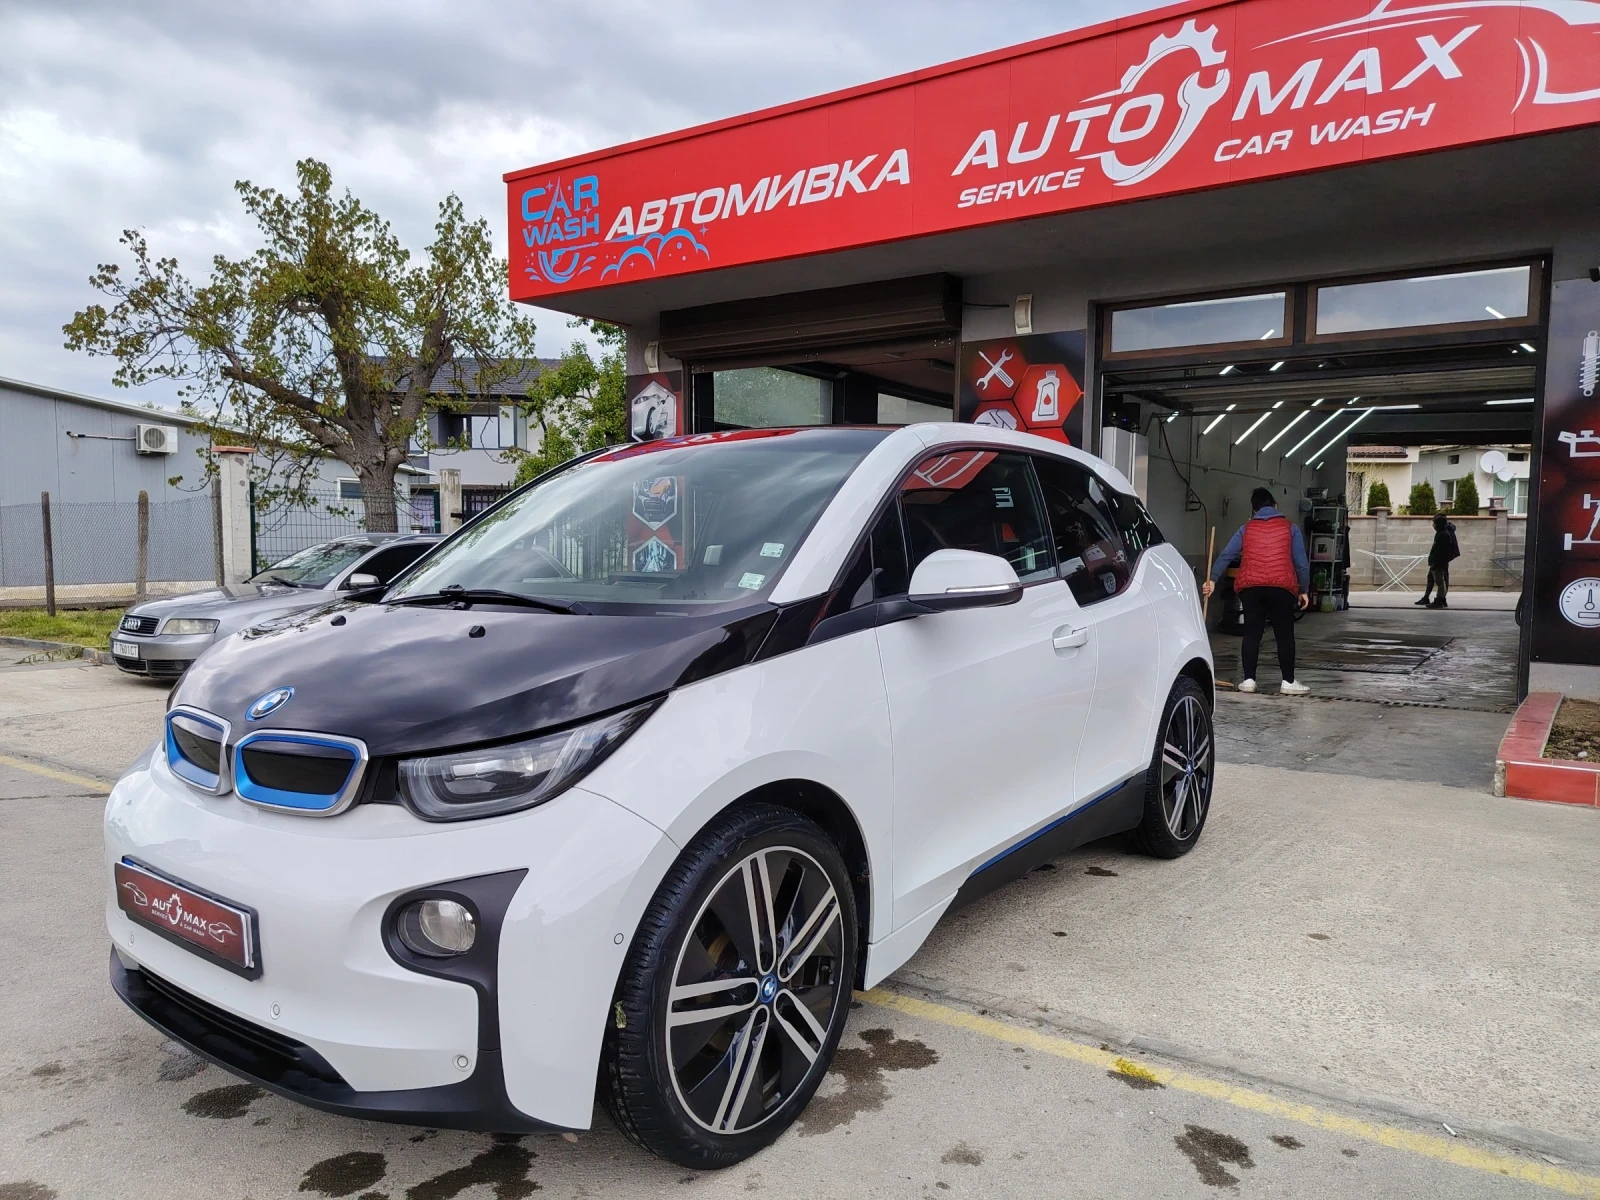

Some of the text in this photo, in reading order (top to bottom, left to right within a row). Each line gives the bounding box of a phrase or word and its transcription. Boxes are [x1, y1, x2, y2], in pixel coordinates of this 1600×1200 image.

[951, 24, 1483, 177] AUTO MAX
[957, 102, 1436, 208] SERVICE CAR WASH
[522, 175, 599, 223] CAR
[604, 148, 910, 241] АВТОМИВКА
[522, 213, 600, 248] WASH
[183, 911, 207, 931] MAX
